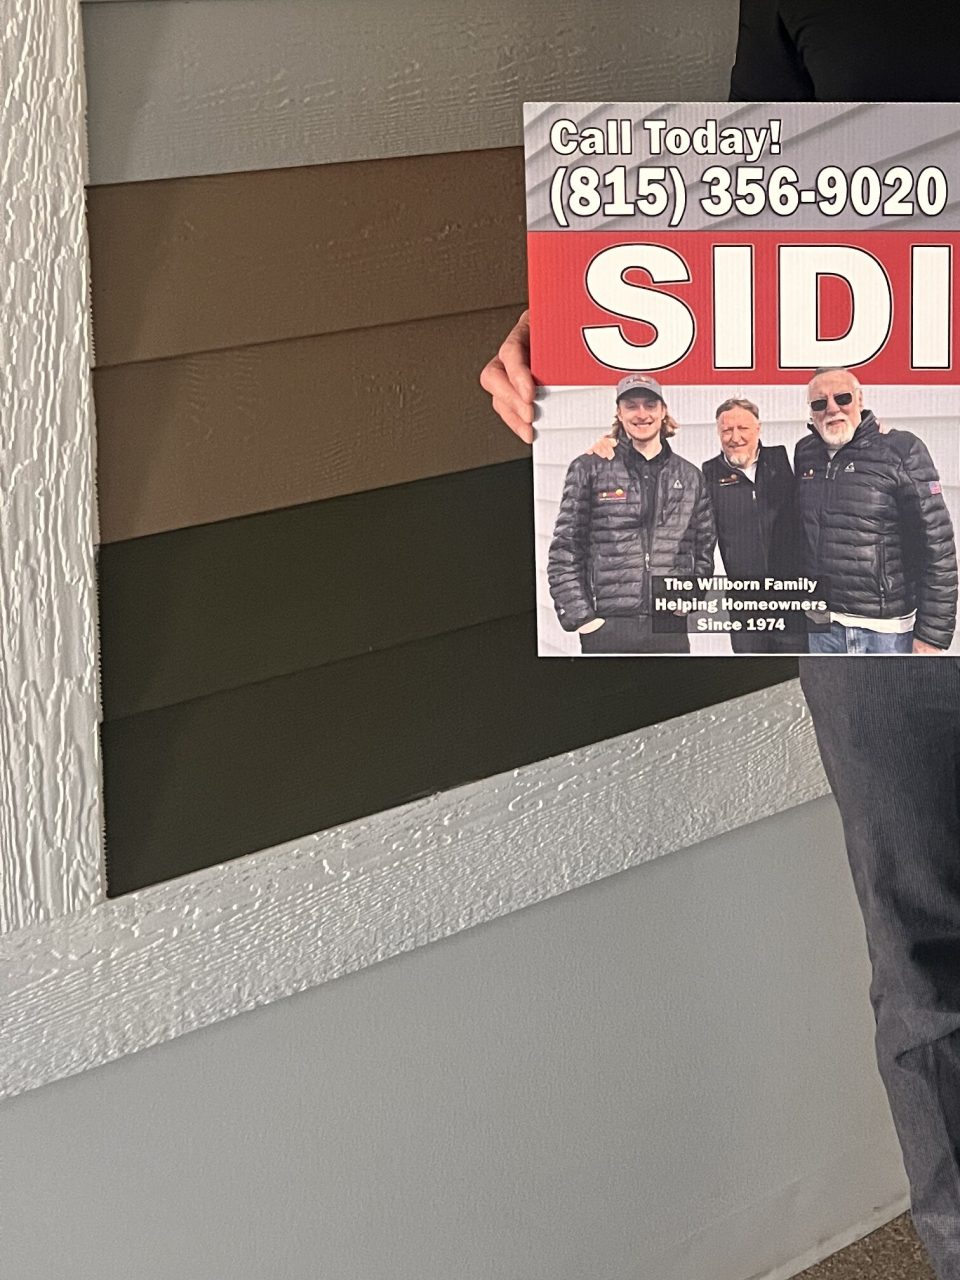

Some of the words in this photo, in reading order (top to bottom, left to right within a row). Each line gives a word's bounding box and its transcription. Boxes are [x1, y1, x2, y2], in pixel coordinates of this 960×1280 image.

[550, 119, 633, 155] Call
[643, 119, 782, 162] Today!
[549, 165, 687, 227] (815)
[699, 165, 949, 218] 356-9020
[664, 578, 693, 591] The
[697, 577, 761, 591] Wilborn
[764, 578, 818, 594] Family
[655, 598, 718, 613] Helping
[721, 598, 828, 612] Homeowners
[697, 617, 743, 631] Since
[746, 618, 786, 632] 1974
